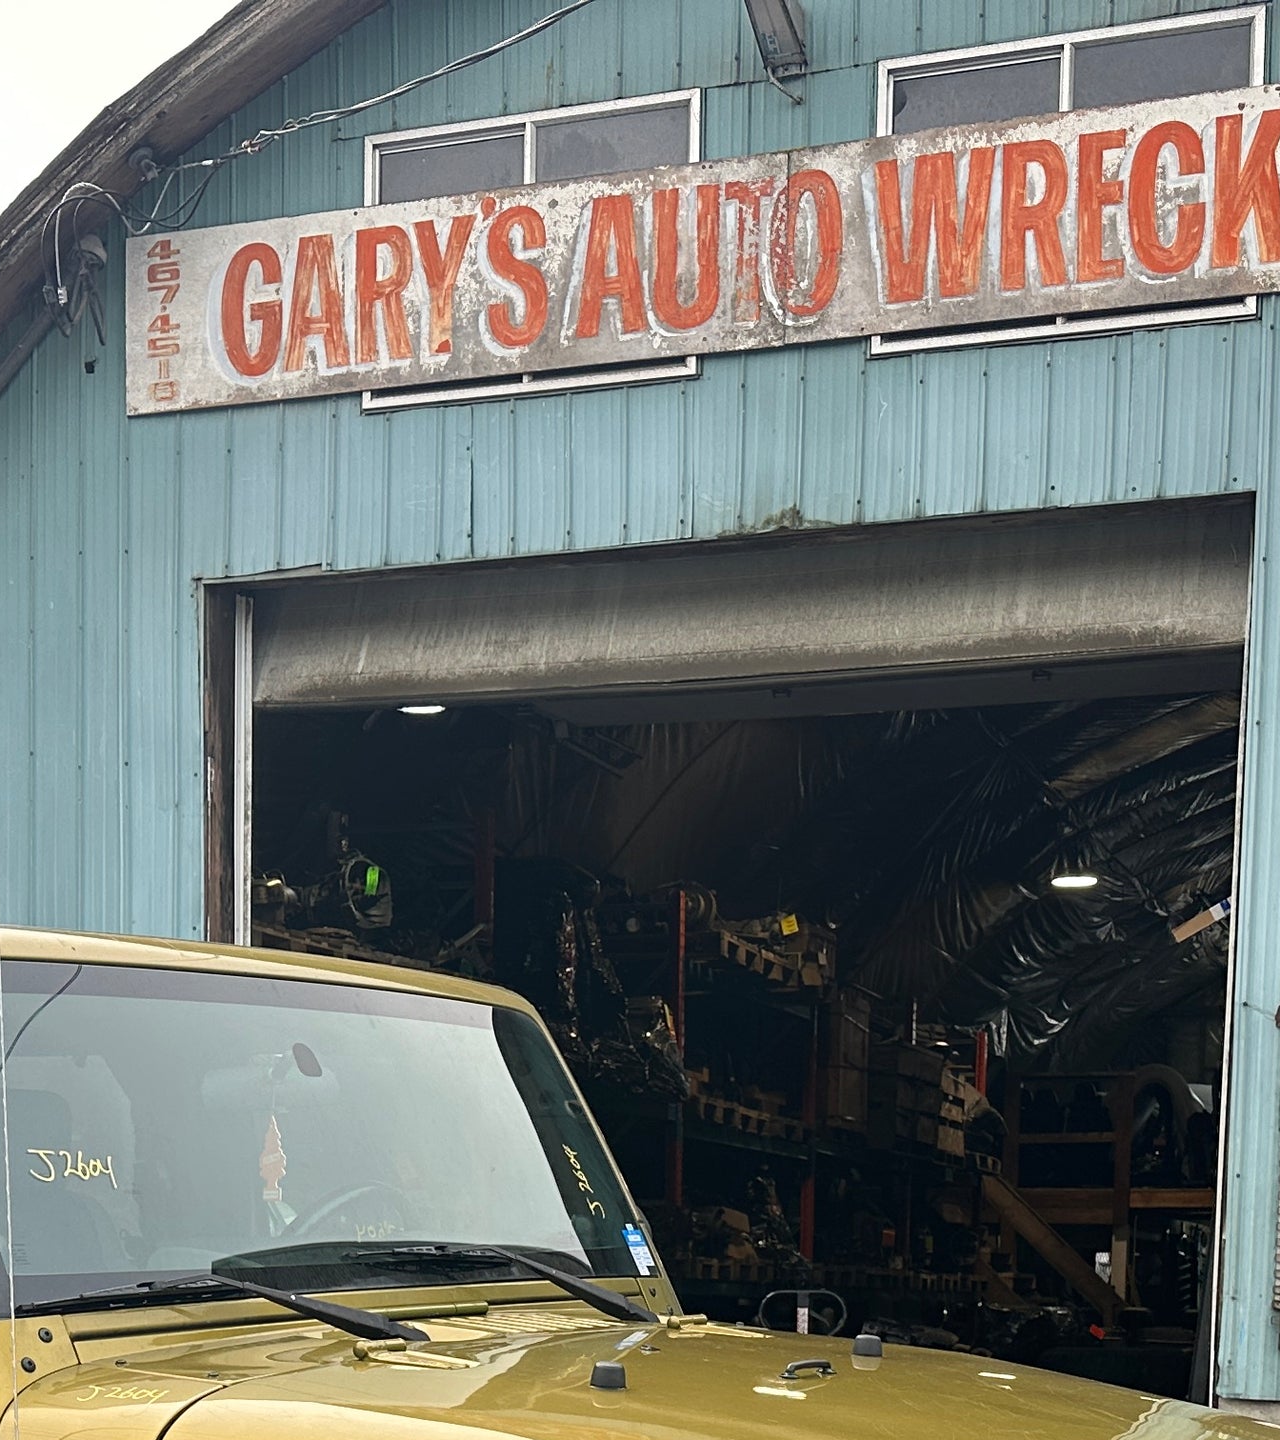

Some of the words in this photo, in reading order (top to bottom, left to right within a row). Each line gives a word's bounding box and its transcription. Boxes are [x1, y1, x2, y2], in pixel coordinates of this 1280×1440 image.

[218, 196, 549, 379] GARY'S
[576, 168, 845, 341] AUTO
[28, 1148, 118, 1189] J2604
[76, 1383, 170, 1405] J2604
